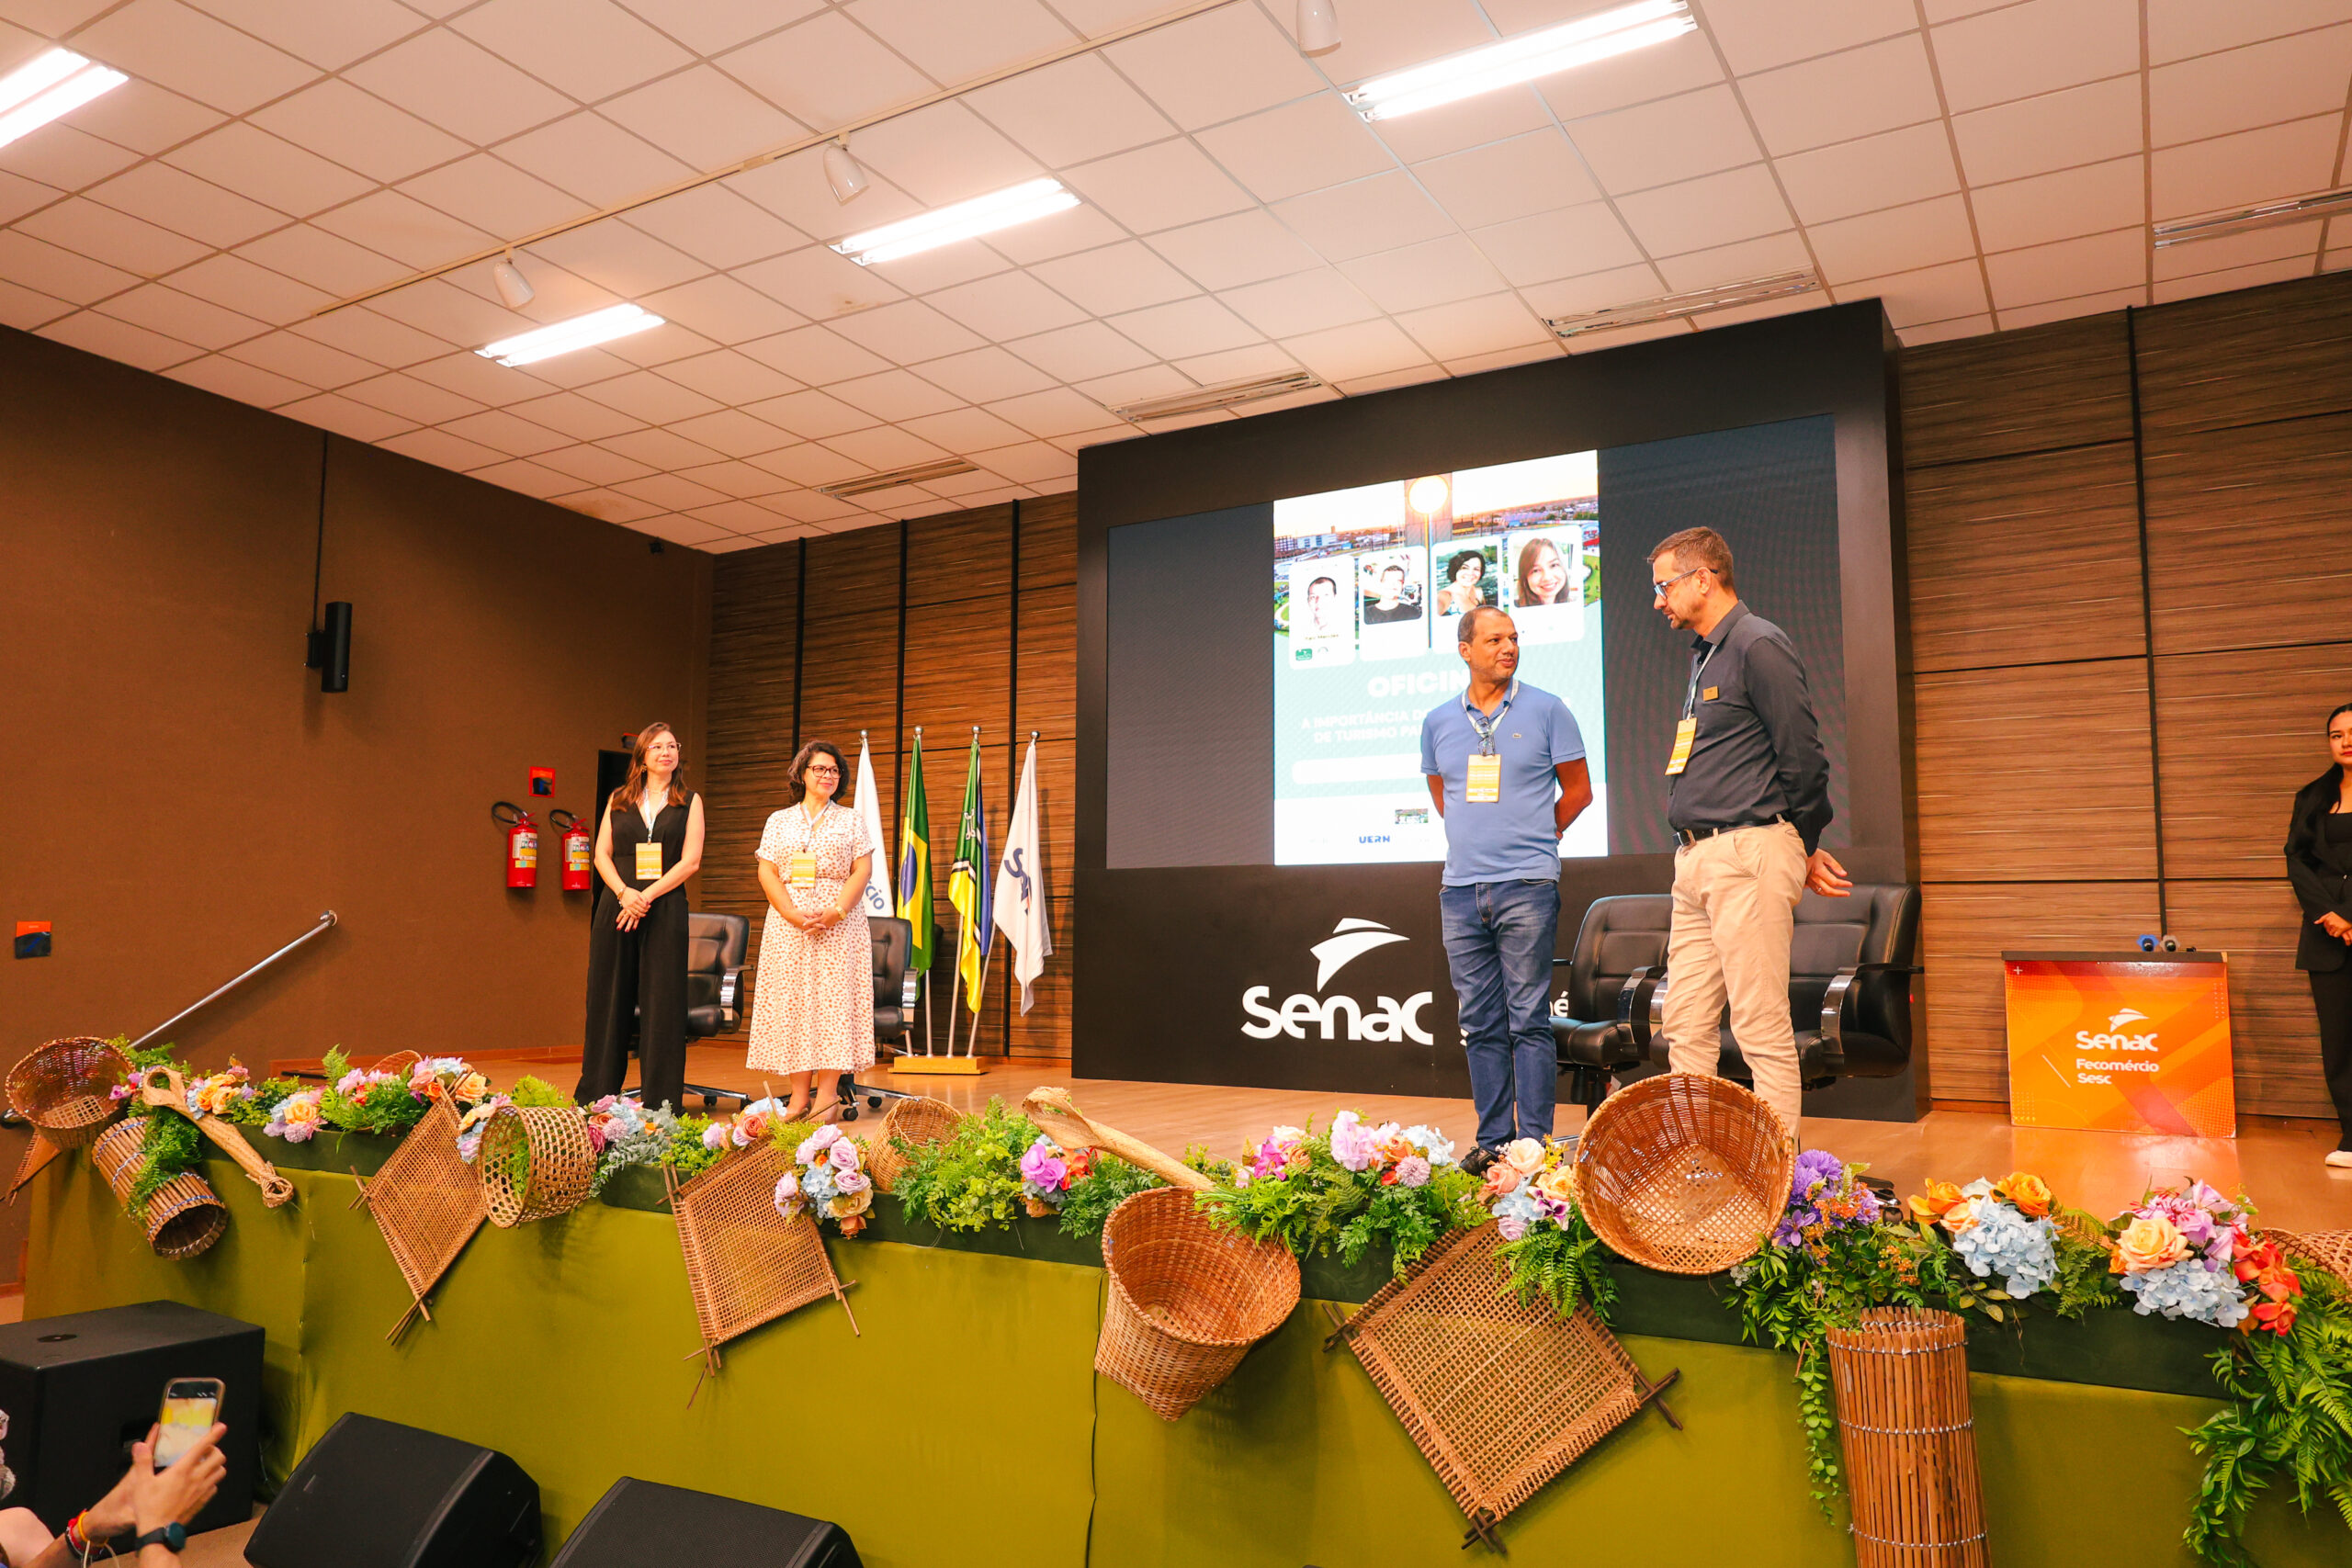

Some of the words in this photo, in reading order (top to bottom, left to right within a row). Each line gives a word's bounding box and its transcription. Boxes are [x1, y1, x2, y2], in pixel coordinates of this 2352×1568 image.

[1367, 669, 1470, 698] OFICIN
[1301, 717, 1311, 729] A
[1313, 710, 1409, 728] IMPORTÂNCIA
[1314, 731, 1331, 744] DE
[1335, 728, 1396, 741] TURISMO
[1359, 835, 1390, 843] UERN
[1241, 986, 1433, 1045] Senac
[2075, 1031, 2158, 1052] Senac
[2075, 1058, 2159, 1072] Fecomércio
[2077, 1073, 2111, 1084] Sesc
